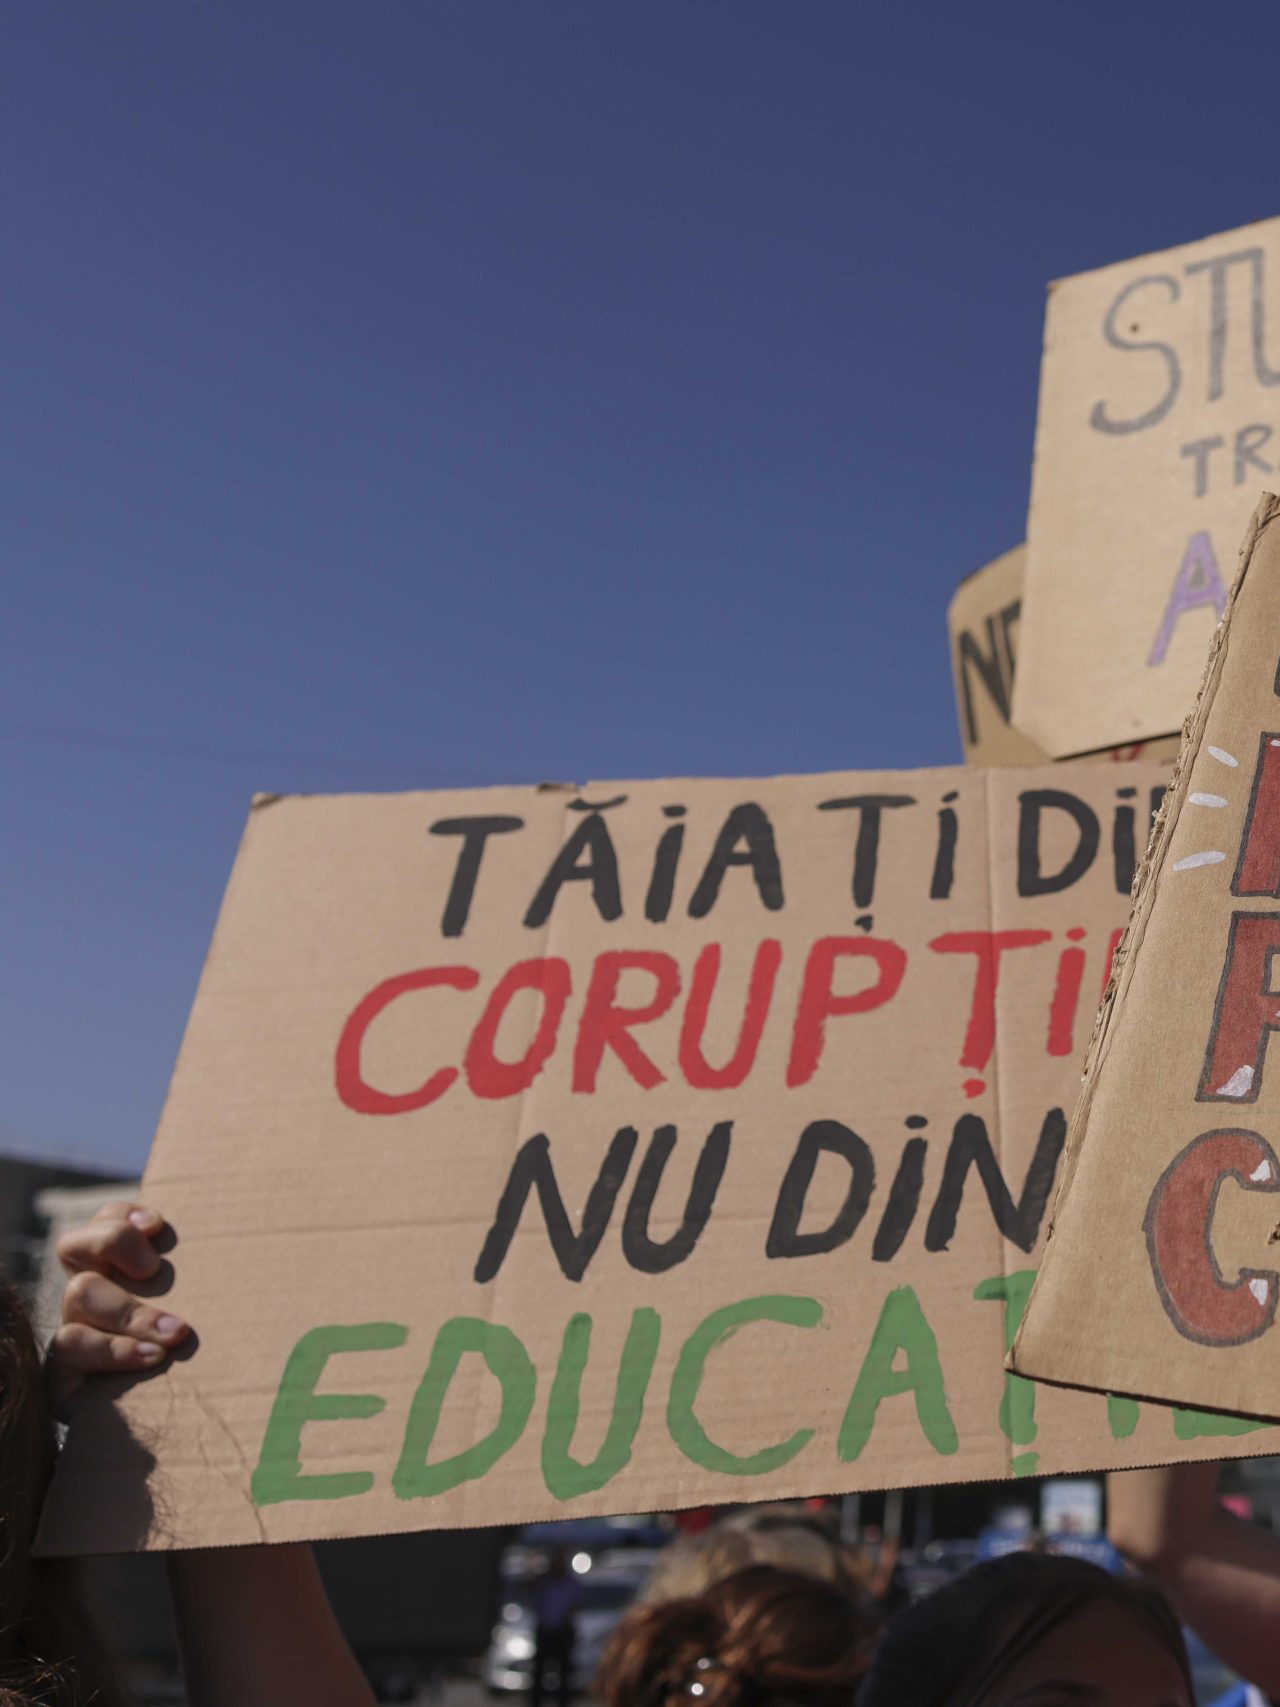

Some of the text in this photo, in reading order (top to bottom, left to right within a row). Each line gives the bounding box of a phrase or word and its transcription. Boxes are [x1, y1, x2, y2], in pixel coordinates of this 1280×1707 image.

[1017, 785, 1168, 897] DI
[334, 926, 1124, 1116] CORUPȚI
[474, 1106, 1067, 1283] NU DIN
[250, 1268, 1278, 1507] EDUCAȚ
